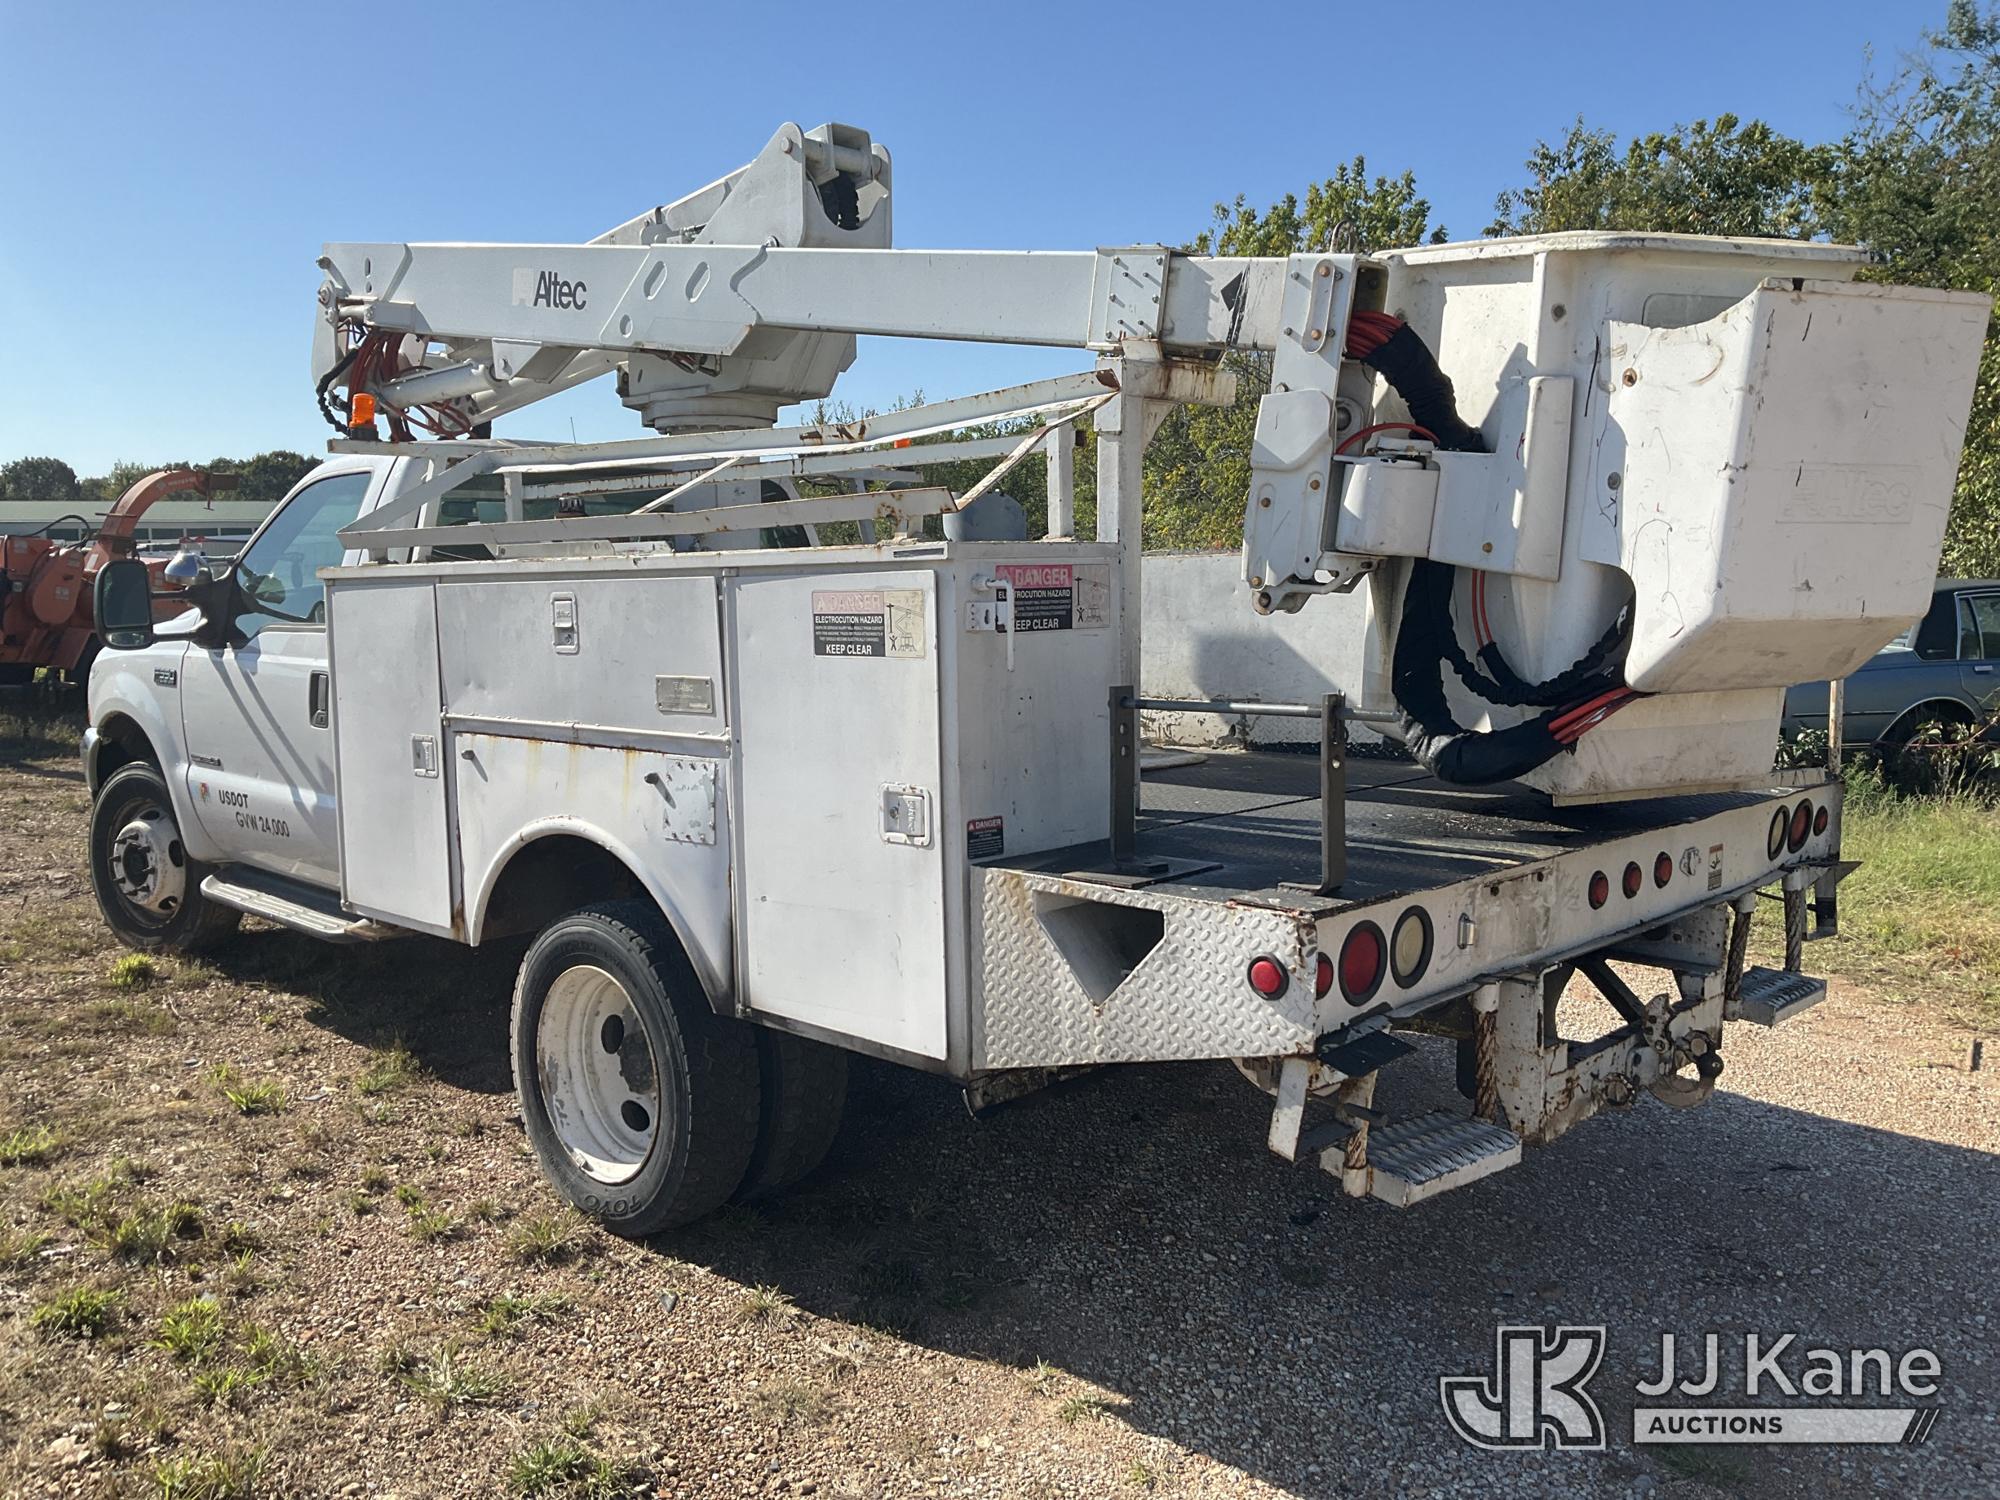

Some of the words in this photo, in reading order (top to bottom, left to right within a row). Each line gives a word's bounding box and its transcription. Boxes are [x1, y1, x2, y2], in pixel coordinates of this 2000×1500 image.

[533, 270, 587, 310] Altec
[1015, 568, 1069, 587] DANGER
[831, 593, 881, 612] DANGER
[1047, 589, 1071, 598] HAZARD
[815, 615, 859, 624] ELECTROCUTION
[859, 615, 883, 623] HAZARD
[1015, 619, 1032, 631] EEP
[1033, 618, 1059, 629] CLEAR
[826, 644, 846, 654] KEEP
[847, 644, 872, 655] CLEAR
[219, 789, 248, 809] USDOT
[235, 811, 259, 831] GVW
[259, 815, 290, 838] 24,000
[584, 1194, 642, 1218] TOYO
